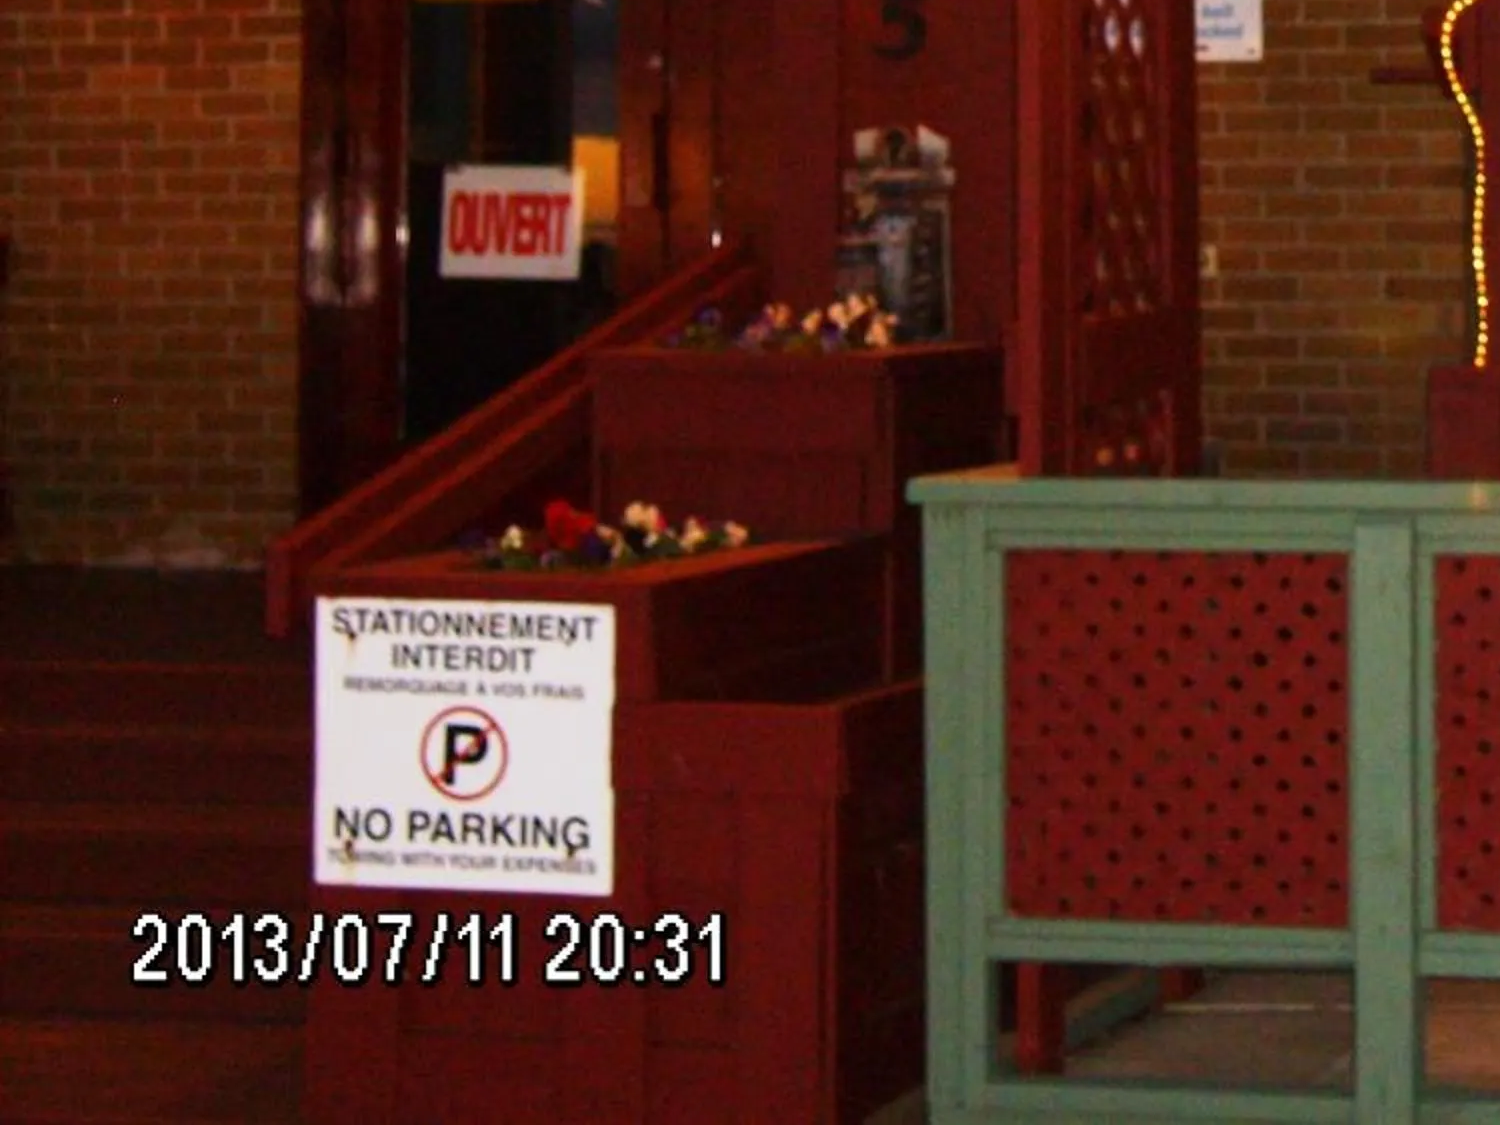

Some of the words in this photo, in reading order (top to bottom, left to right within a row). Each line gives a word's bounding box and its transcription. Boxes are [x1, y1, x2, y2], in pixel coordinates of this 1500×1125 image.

[448, 189, 572, 258] OUVERT
[332, 607, 598, 642] STATIONNEMENT
[391, 644, 536, 673] INTERDIT
[343, 676, 468, 696] REMORQUAGE
[492, 681, 526, 698] VOS
[532, 683, 585, 700] FRAIS
[443, 723, 488, 786] P
[334, 806, 393, 842] NO
[408, 810, 591, 850] PARKING
